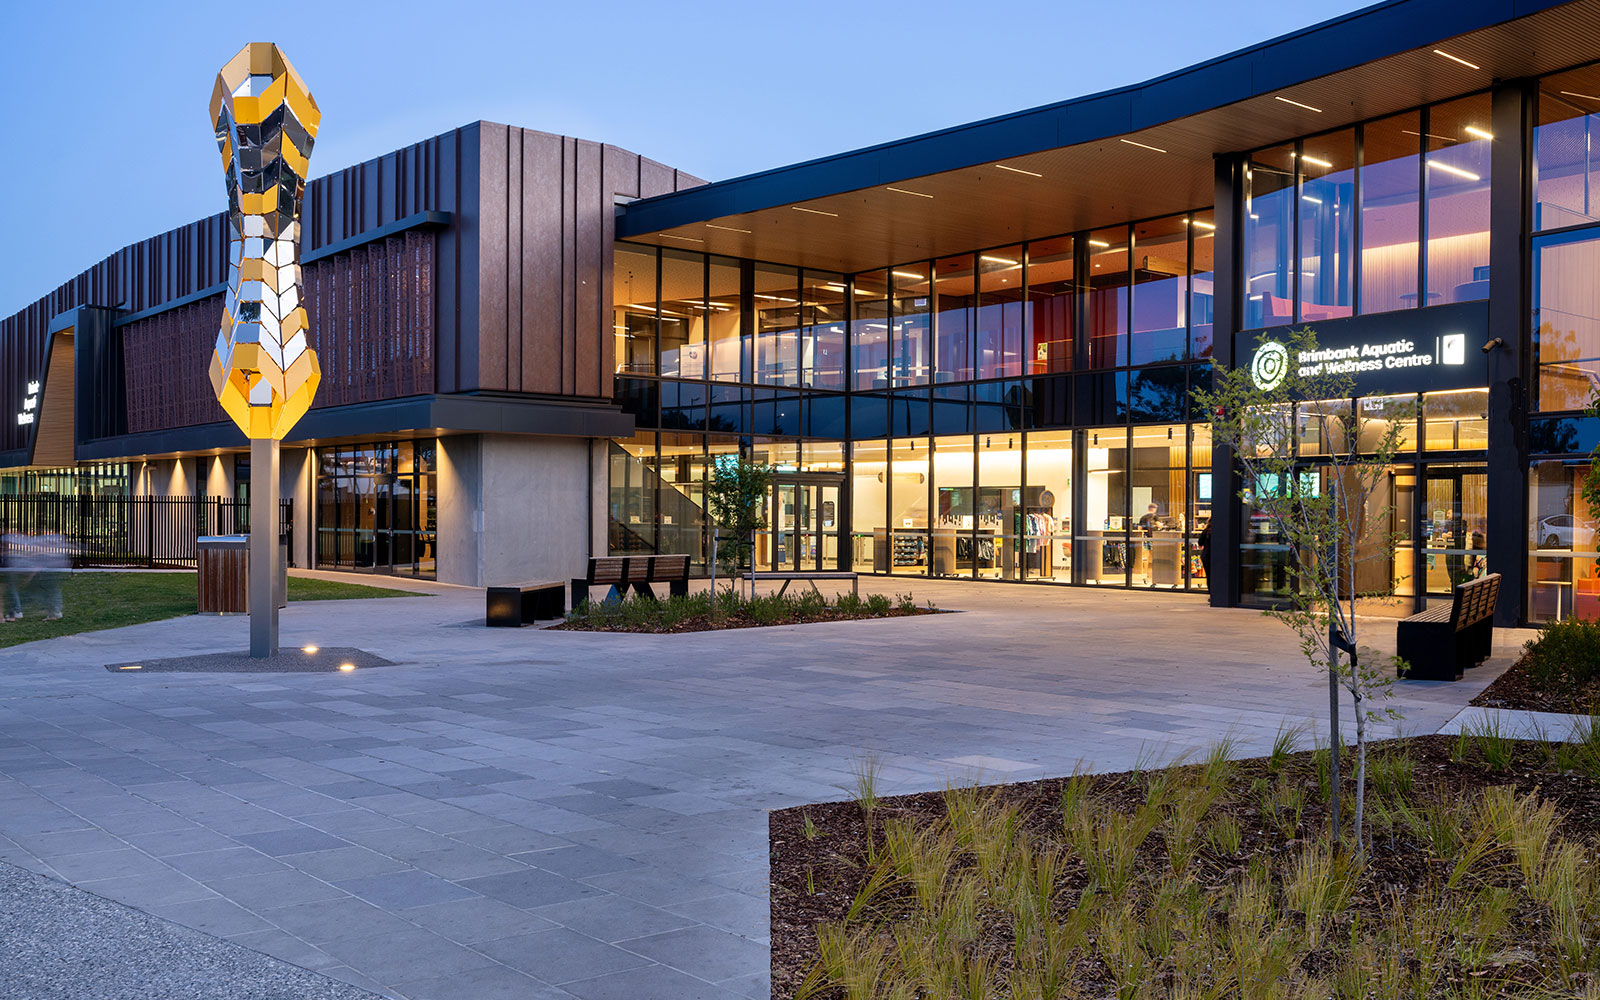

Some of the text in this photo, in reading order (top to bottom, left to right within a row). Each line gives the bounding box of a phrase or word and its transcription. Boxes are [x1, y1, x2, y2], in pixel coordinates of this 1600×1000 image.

[1298, 338, 1415, 363] Brimbank Aquatic
[1297, 354, 1433, 377] and Wellness Centre
